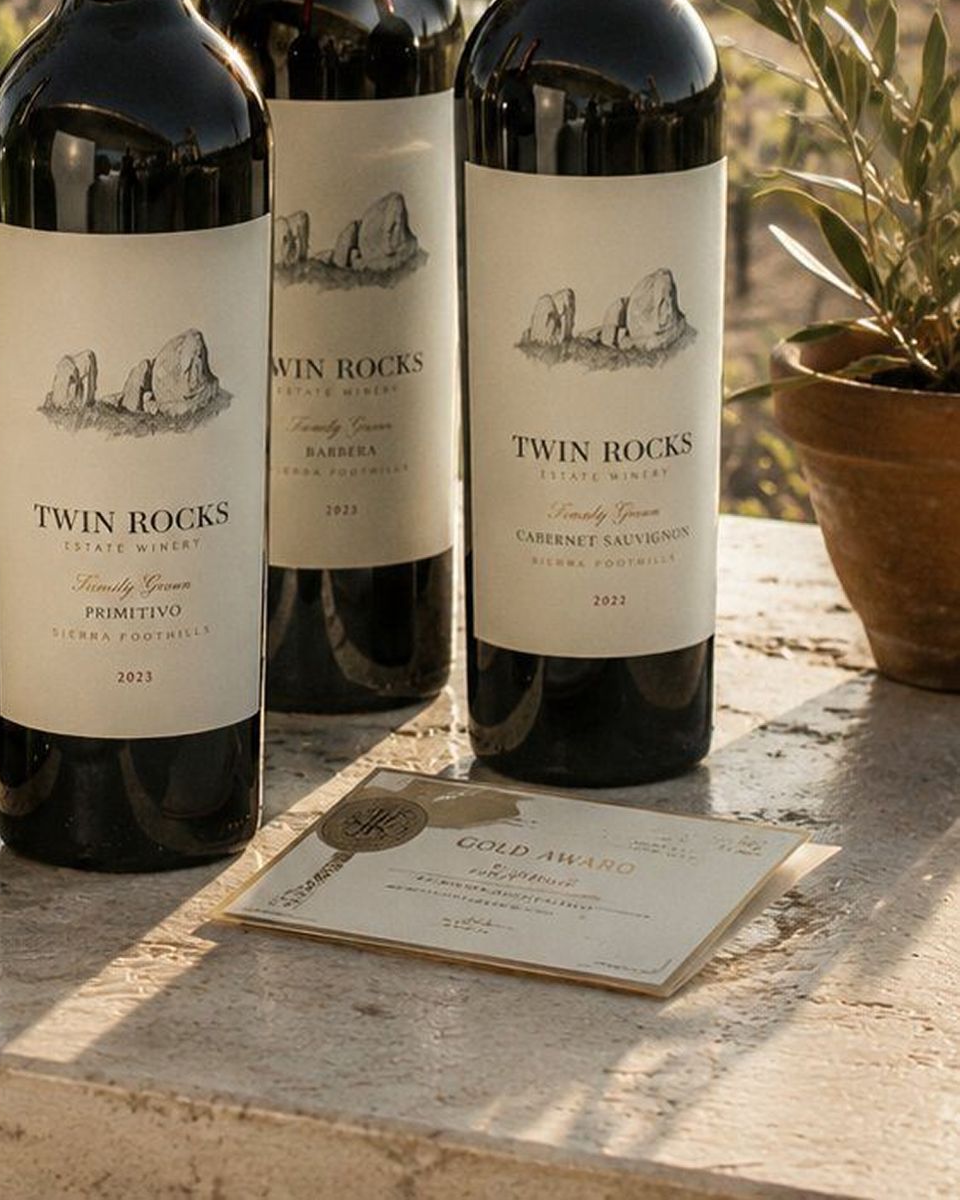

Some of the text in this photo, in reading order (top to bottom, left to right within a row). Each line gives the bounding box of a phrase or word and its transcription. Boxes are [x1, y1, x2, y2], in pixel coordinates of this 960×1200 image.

[272, 352, 424, 380] WIN ROCKS
[512, 432, 693, 464] TWIN ROCKS
[34, 500, 229, 534] TWIN ROCKS
[64, 538, 201, 553] ESTATE WINERY
[515, 524, 691, 548] CABERNET SAUVIGNON
[85, 604, 182, 620] PRIMITIVO
[117, 671, 153, 683] 2023
[455, 835, 530, 857] GOLD
